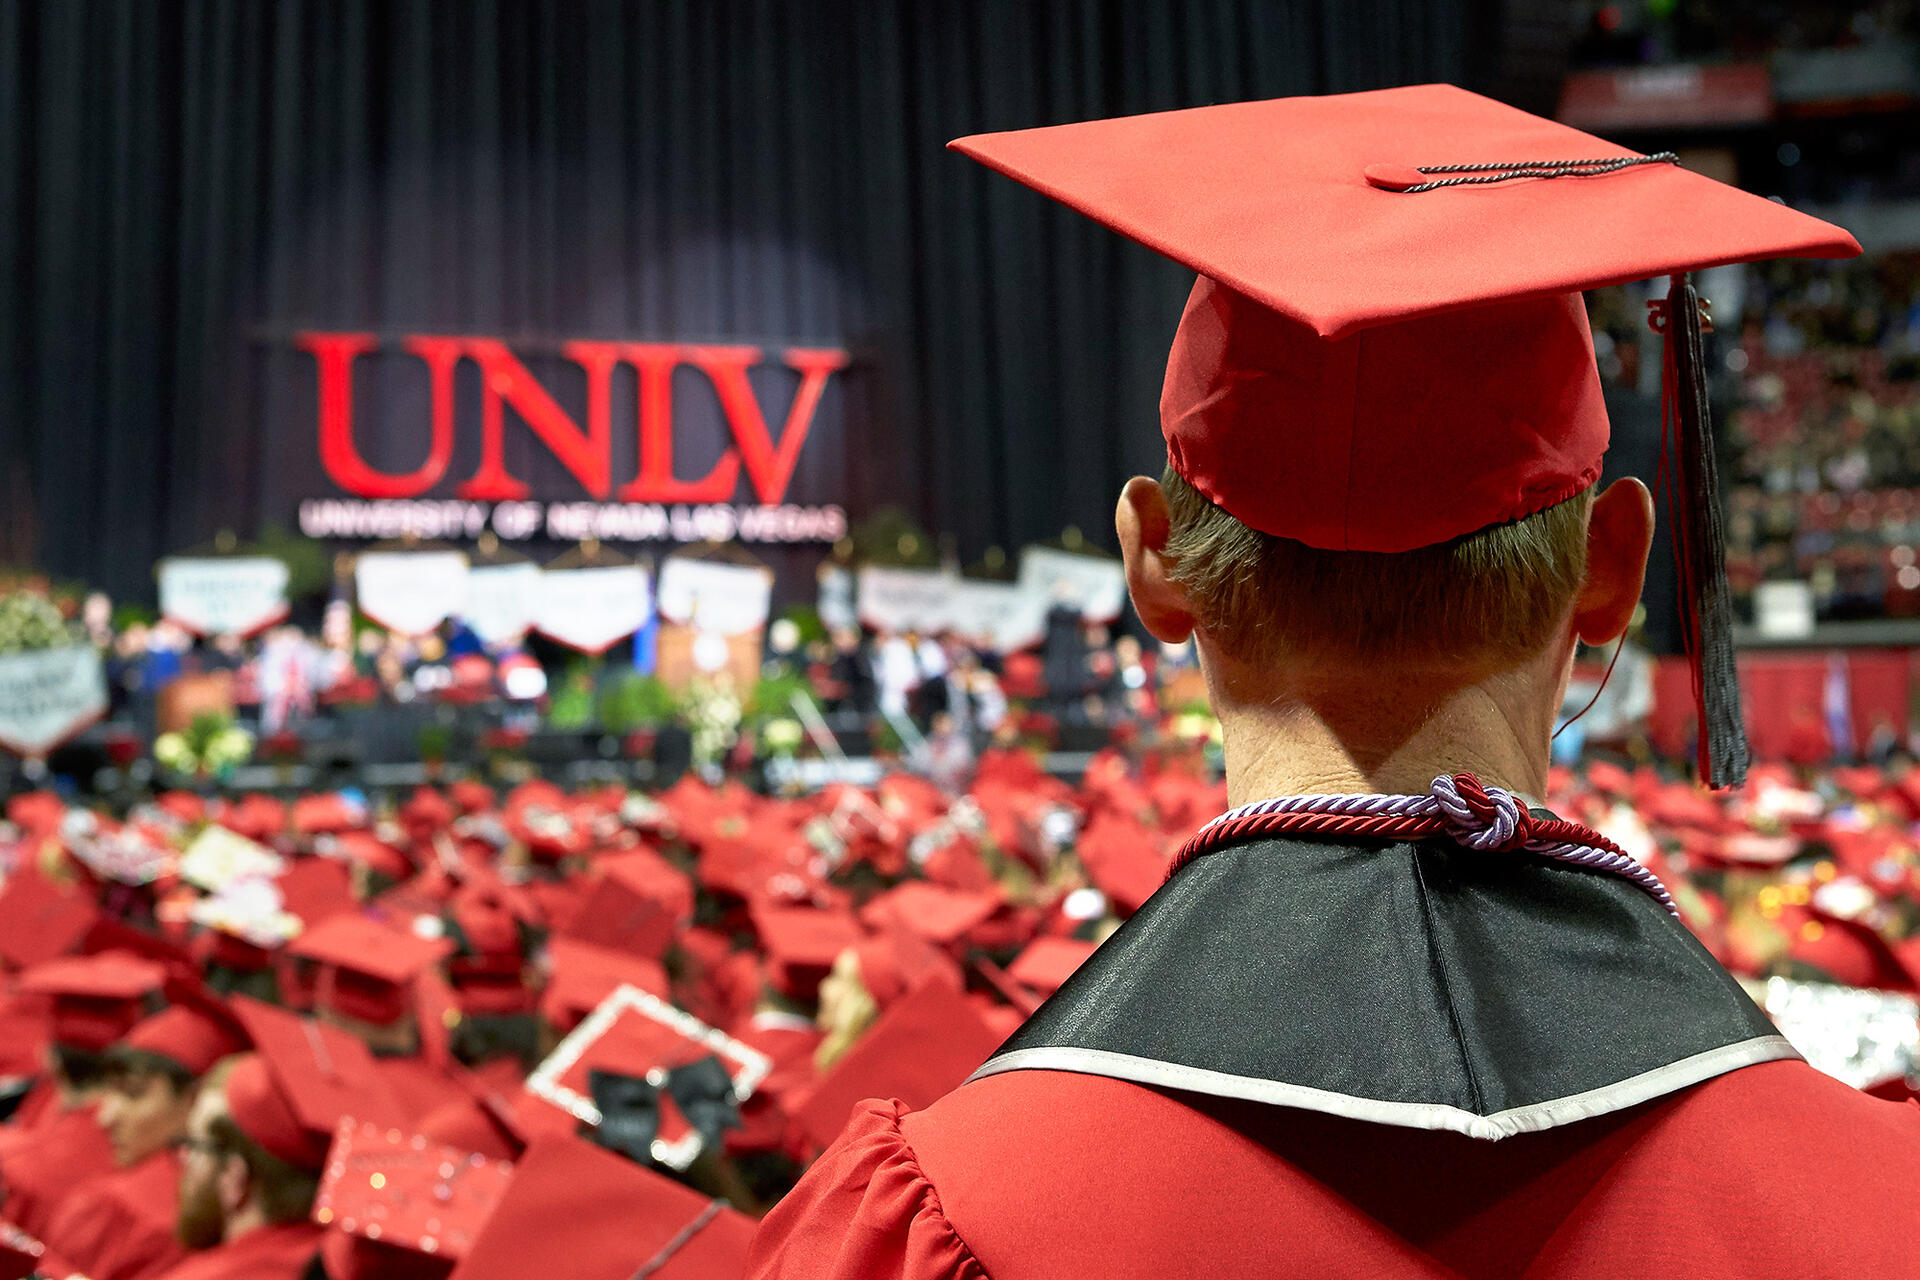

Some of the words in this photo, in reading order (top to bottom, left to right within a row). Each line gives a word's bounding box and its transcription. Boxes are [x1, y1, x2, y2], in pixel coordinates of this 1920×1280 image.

[296, 331, 850, 507] UNLV
[300, 500, 488, 539] UNIVERSITY
[492, 501, 544, 540] OF
[547, 501, 669, 541] NEVADA
[671, 503, 735, 542] LAS
[736, 504, 847, 542] VEGAS
